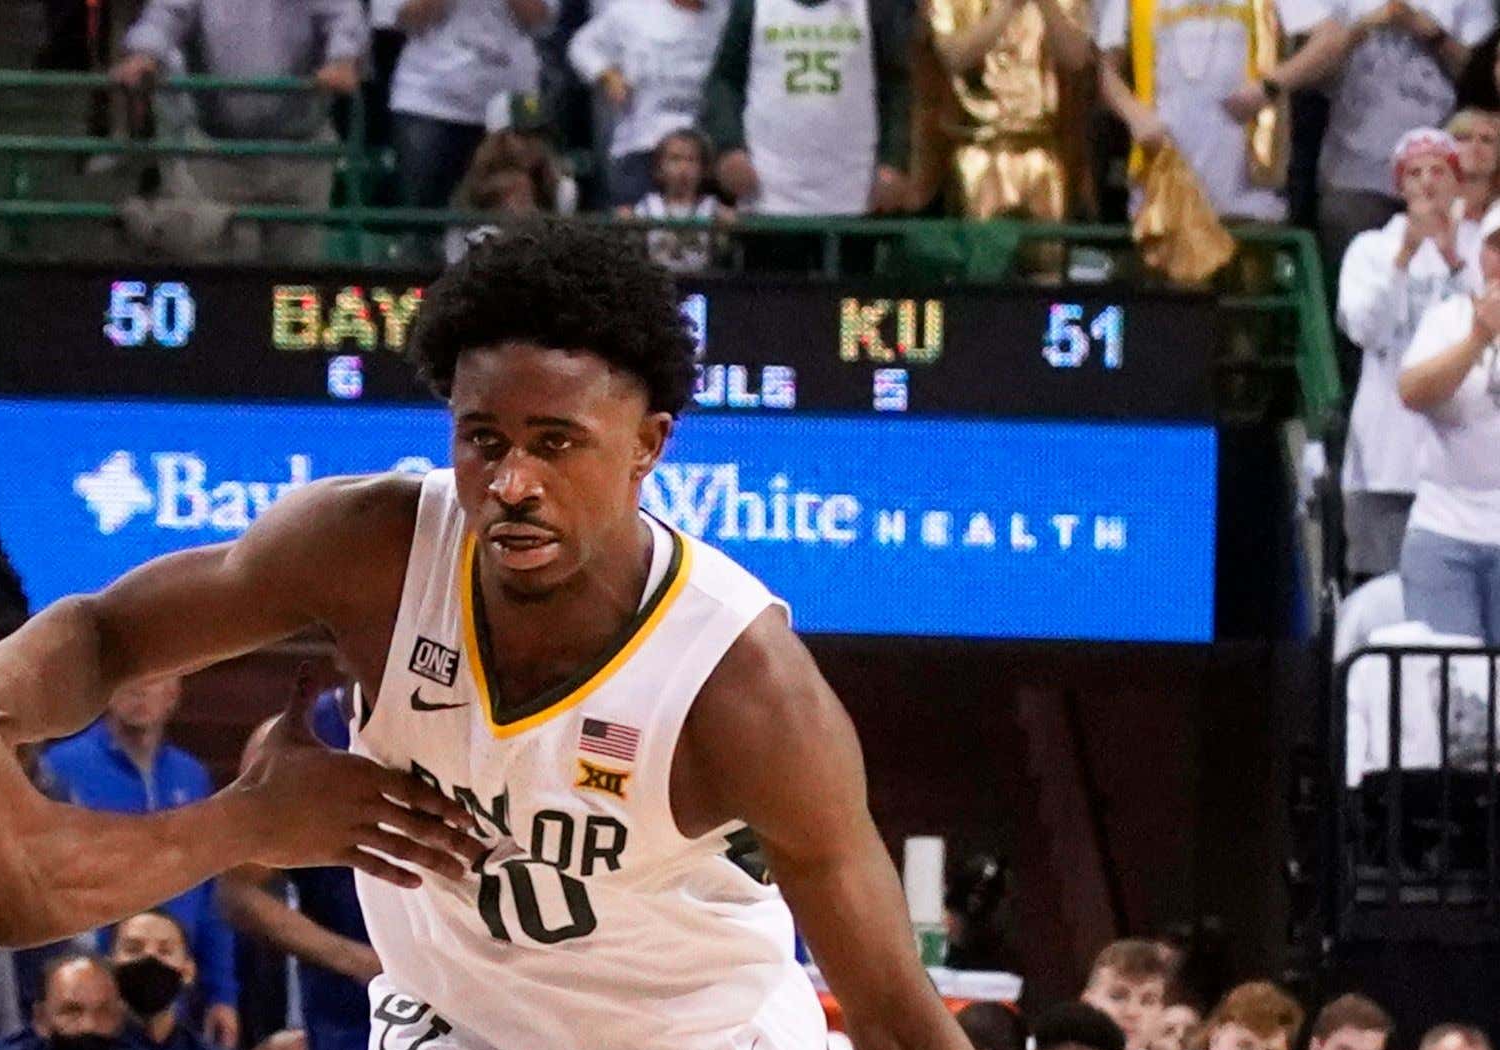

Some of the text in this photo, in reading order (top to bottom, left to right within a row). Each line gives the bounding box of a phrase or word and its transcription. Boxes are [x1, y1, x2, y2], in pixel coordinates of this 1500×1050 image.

[784, 50, 841, 95] 25
[104, 281, 197, 348] 50
[272, 284, 424, 351] BAY
[840, 297, 945, 364] KU
[1042, 303, 1125, 369] 51
[692, 364, 798, 409] ULS
[873, 508, 1128, 551] HEALTH
[414, 640, 458, 680] ONE
[470, 850, 599, 945] 10
